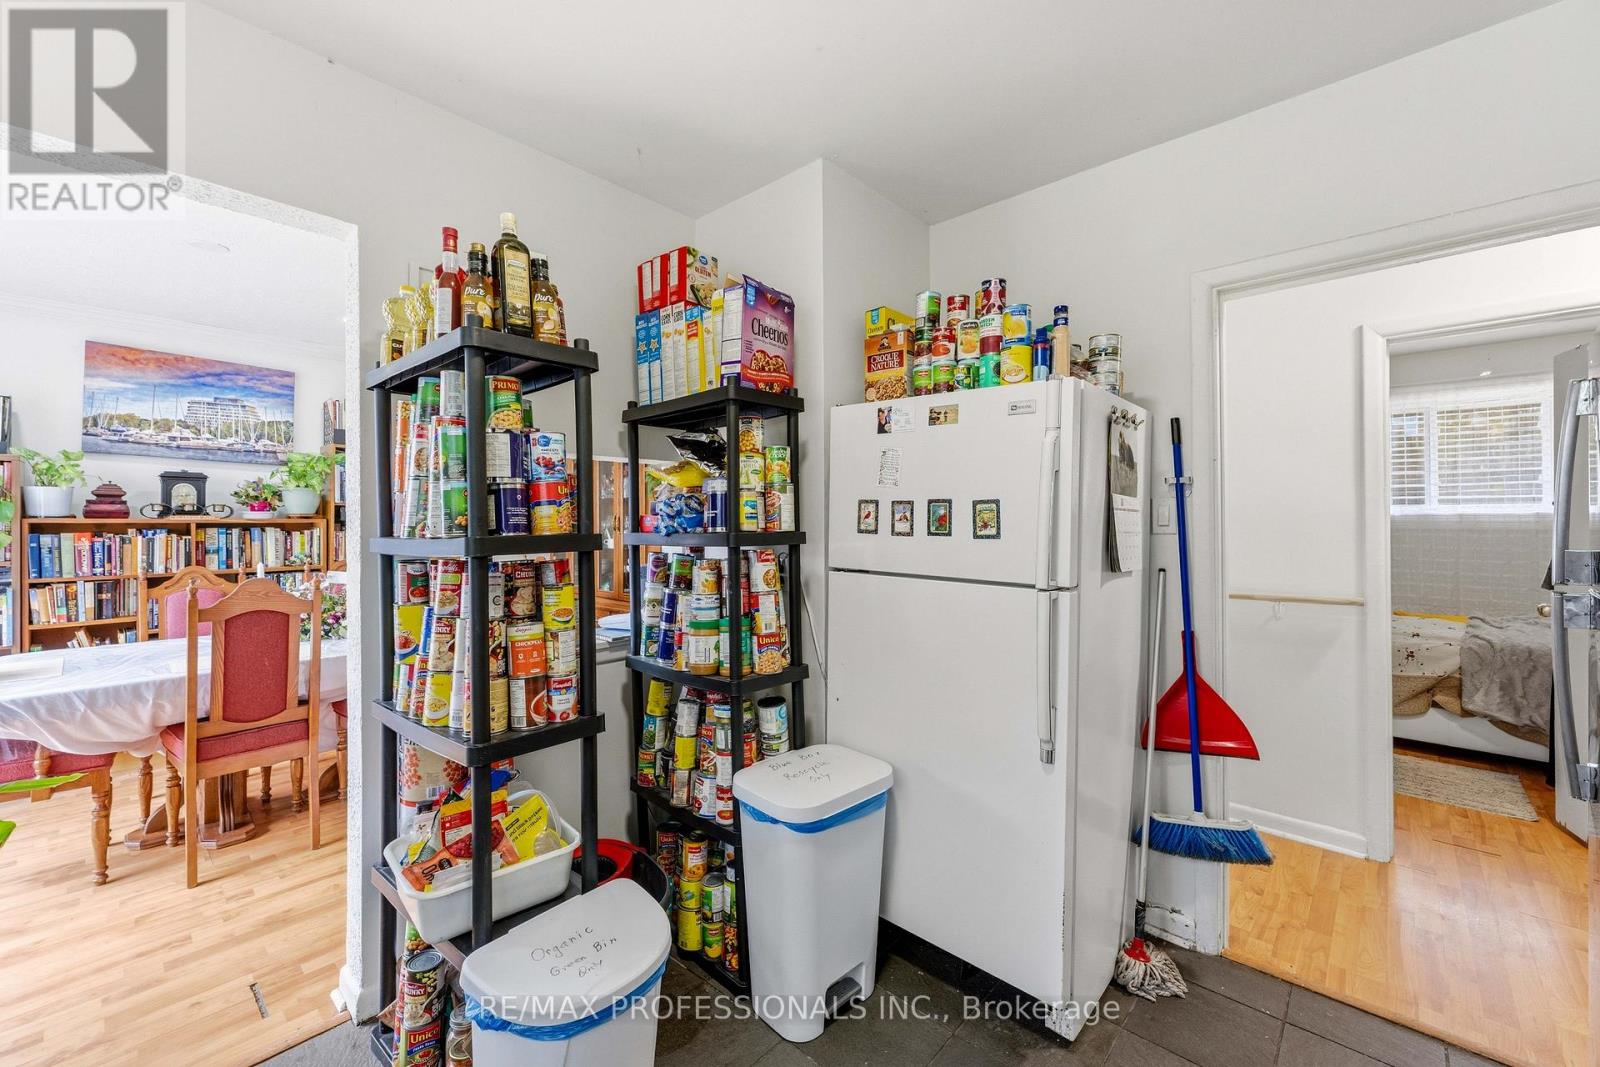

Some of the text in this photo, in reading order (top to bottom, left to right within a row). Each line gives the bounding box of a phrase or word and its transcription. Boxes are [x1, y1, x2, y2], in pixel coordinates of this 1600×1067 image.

[751, 317, 789, 346] Cheerios
[870, 352, 900, 364] CROQUE
[870, 360, 900, 372] NATURE
[491, 381, 519, 391] PRIMO
[530, 926, 594, 962] Organic
[593, 938, 617, 953] Bin
[410, 1027, 440, 1044] Unico
